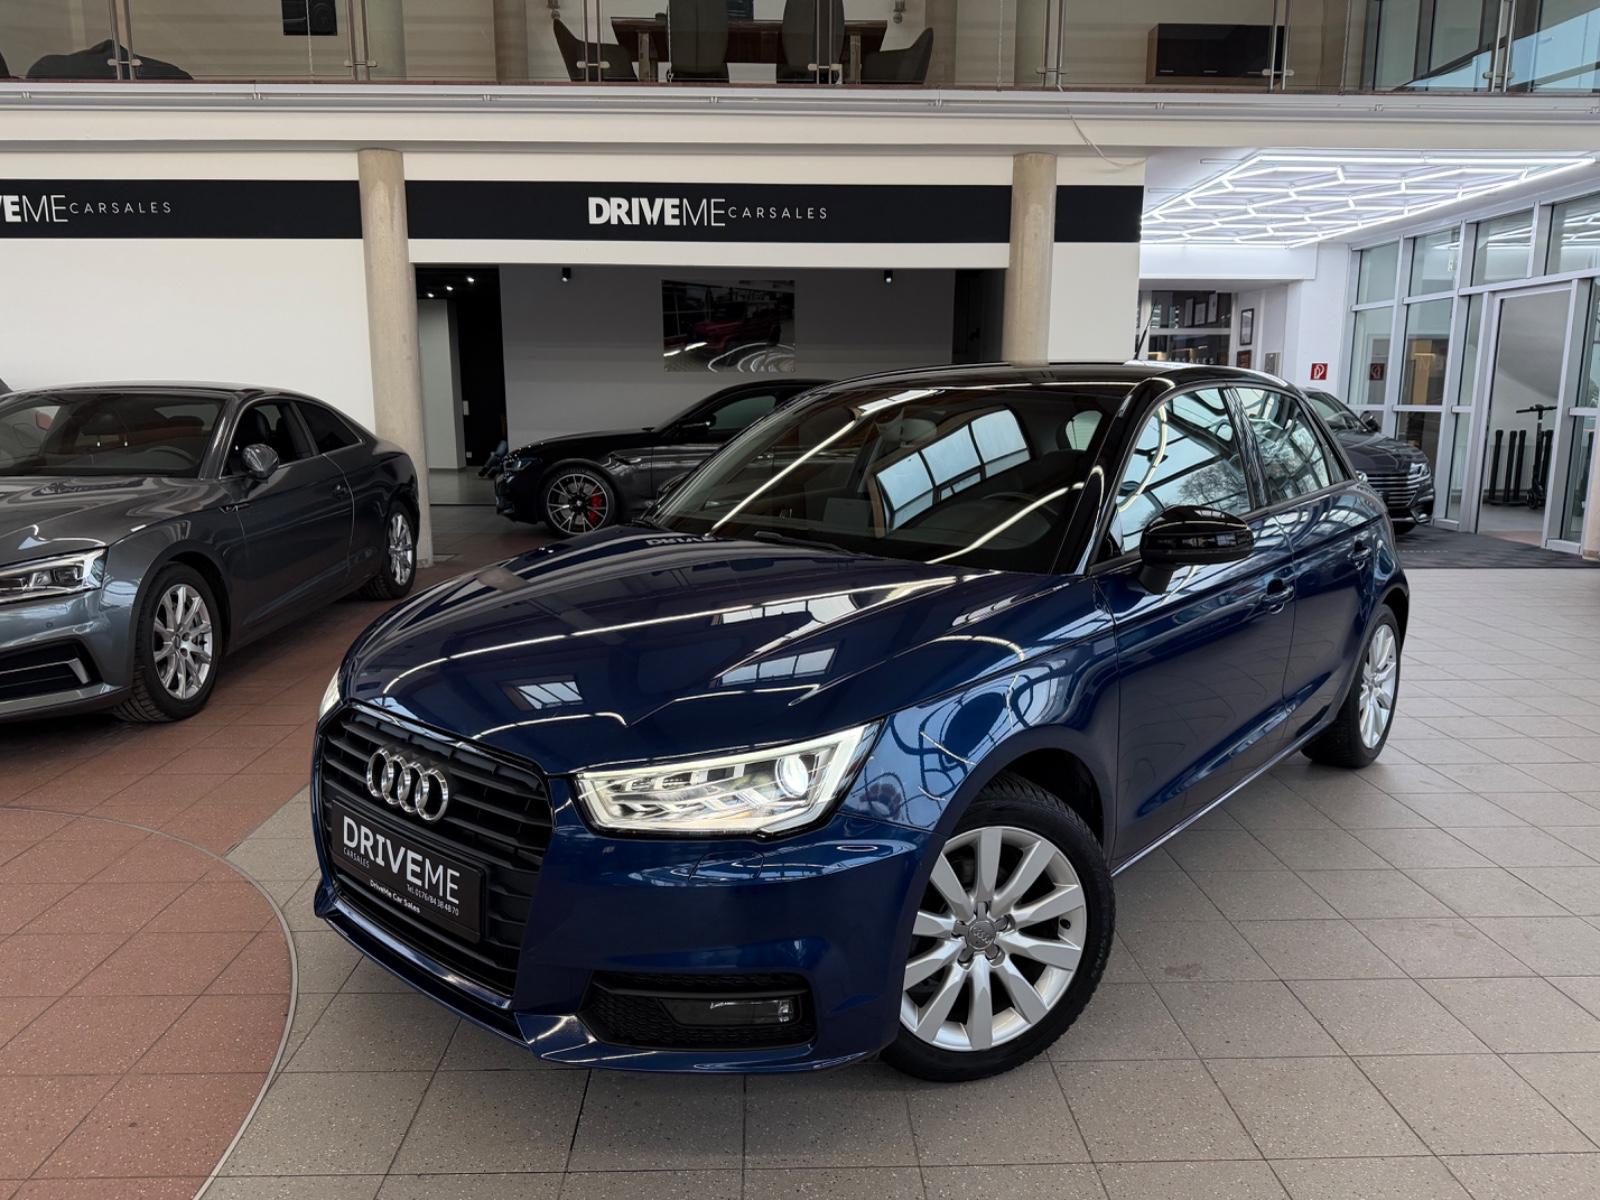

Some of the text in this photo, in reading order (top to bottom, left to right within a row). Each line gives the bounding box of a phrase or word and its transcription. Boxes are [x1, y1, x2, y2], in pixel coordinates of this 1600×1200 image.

[0, 194, 172, 223] EME CARSALES
[588, 196, 828, 227] DRIVEME CARSALES
[343, 815, 460, 904] DRIVEME
